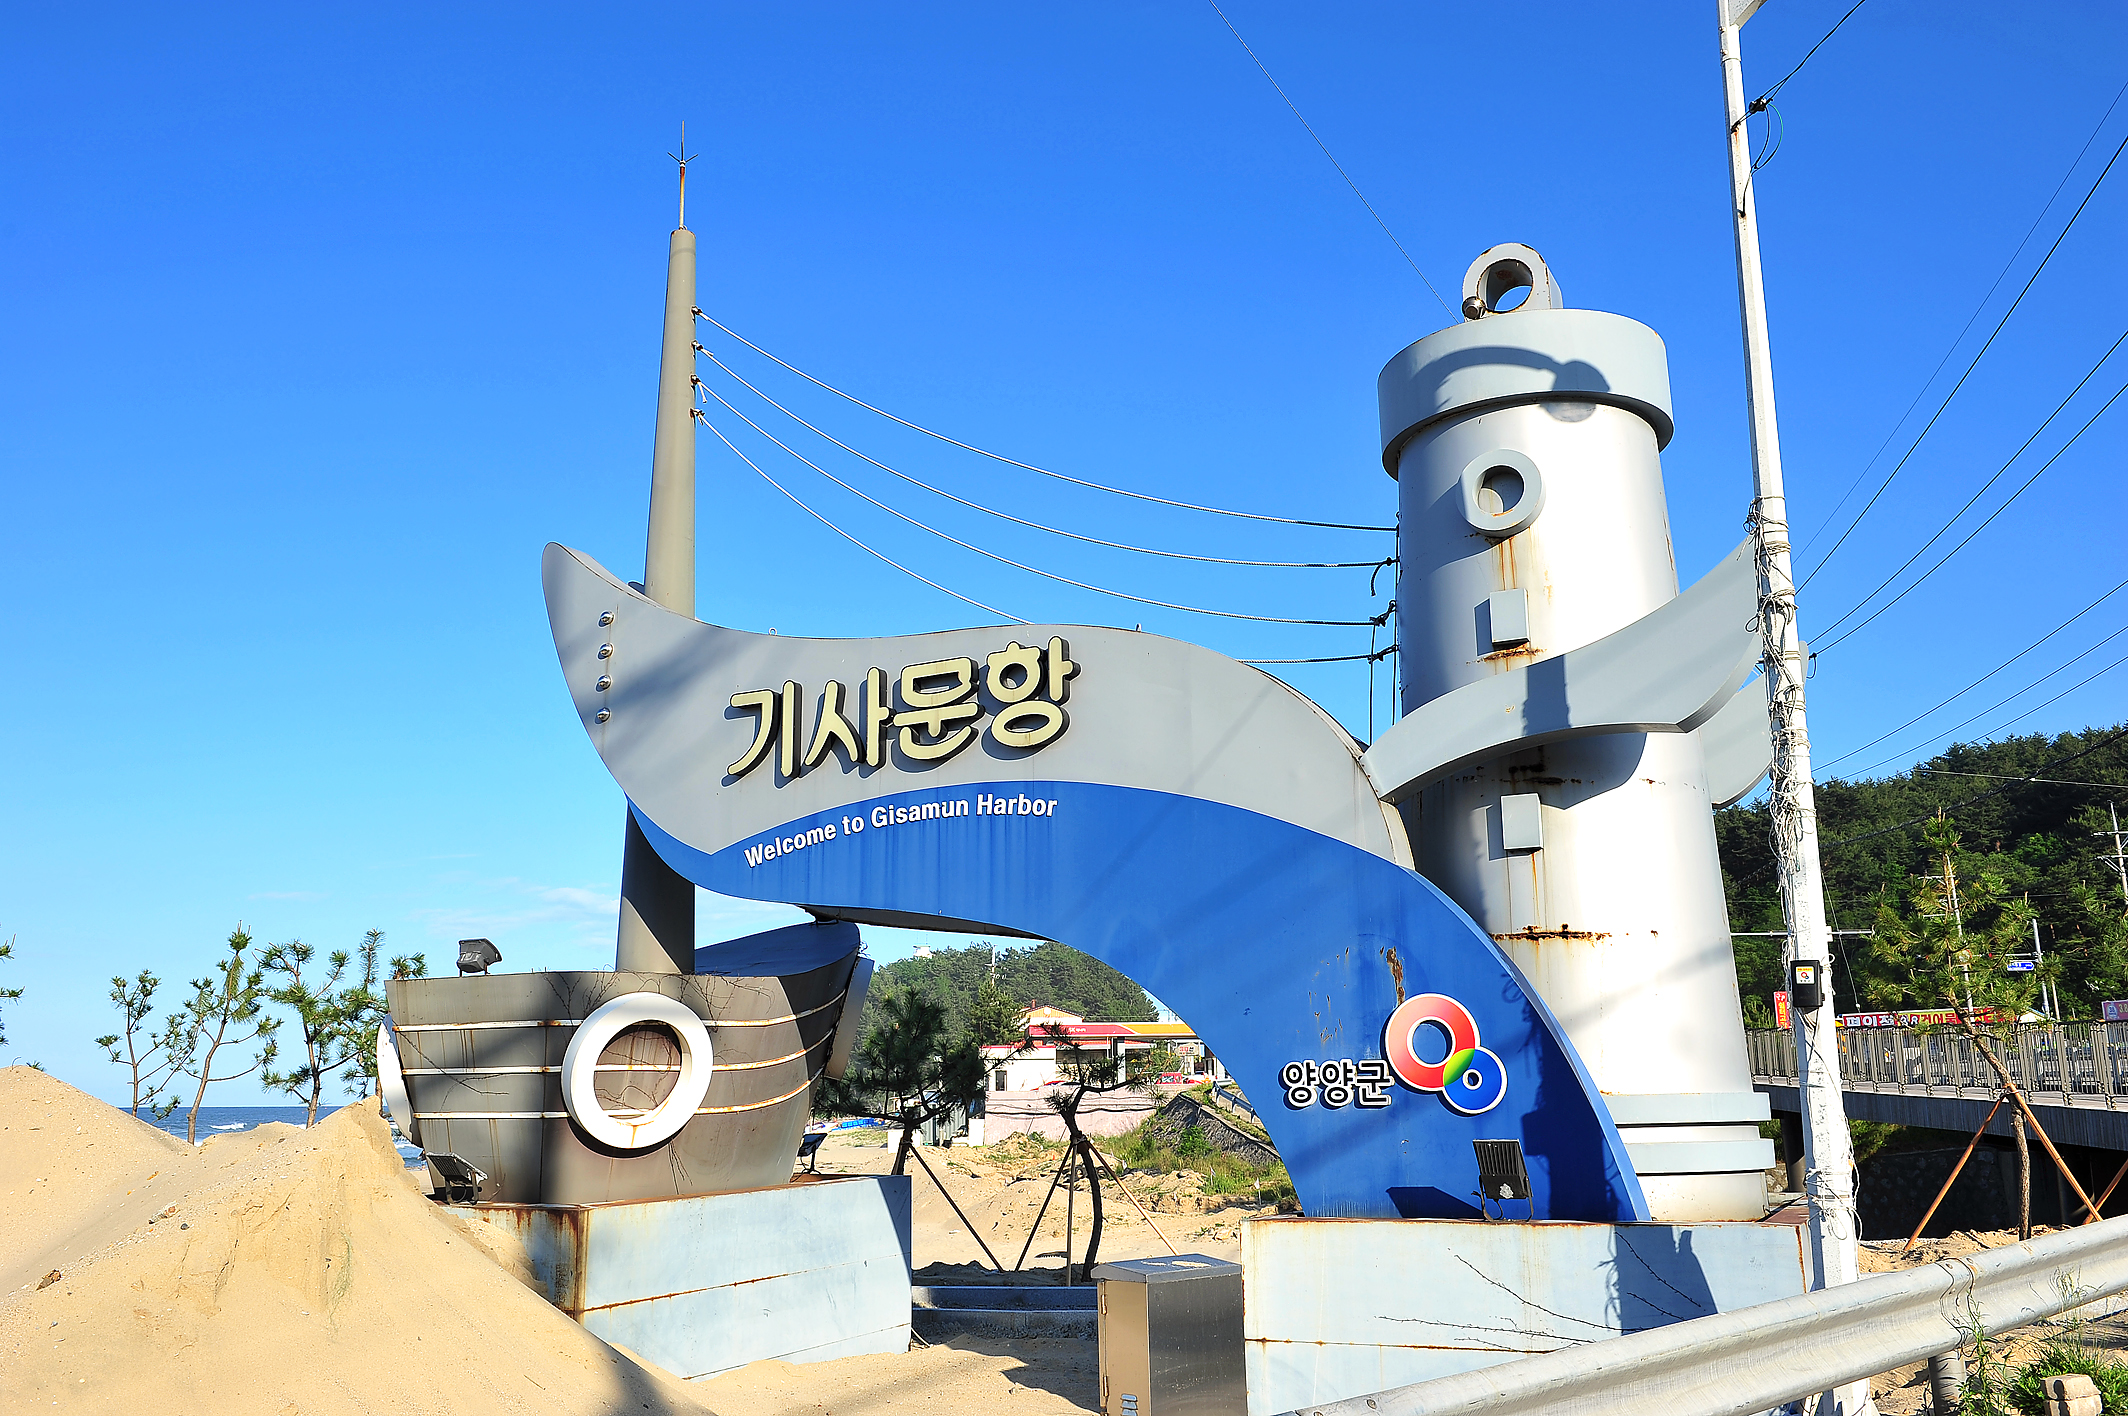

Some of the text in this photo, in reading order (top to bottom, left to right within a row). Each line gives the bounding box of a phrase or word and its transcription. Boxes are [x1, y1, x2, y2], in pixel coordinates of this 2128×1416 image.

[725, 636, 1081, 780] 기사문항
[744, 793, 1058, 869] Welcome to Gisamun Harbor
[1282, 1059, 1396, 1107] 양양군
